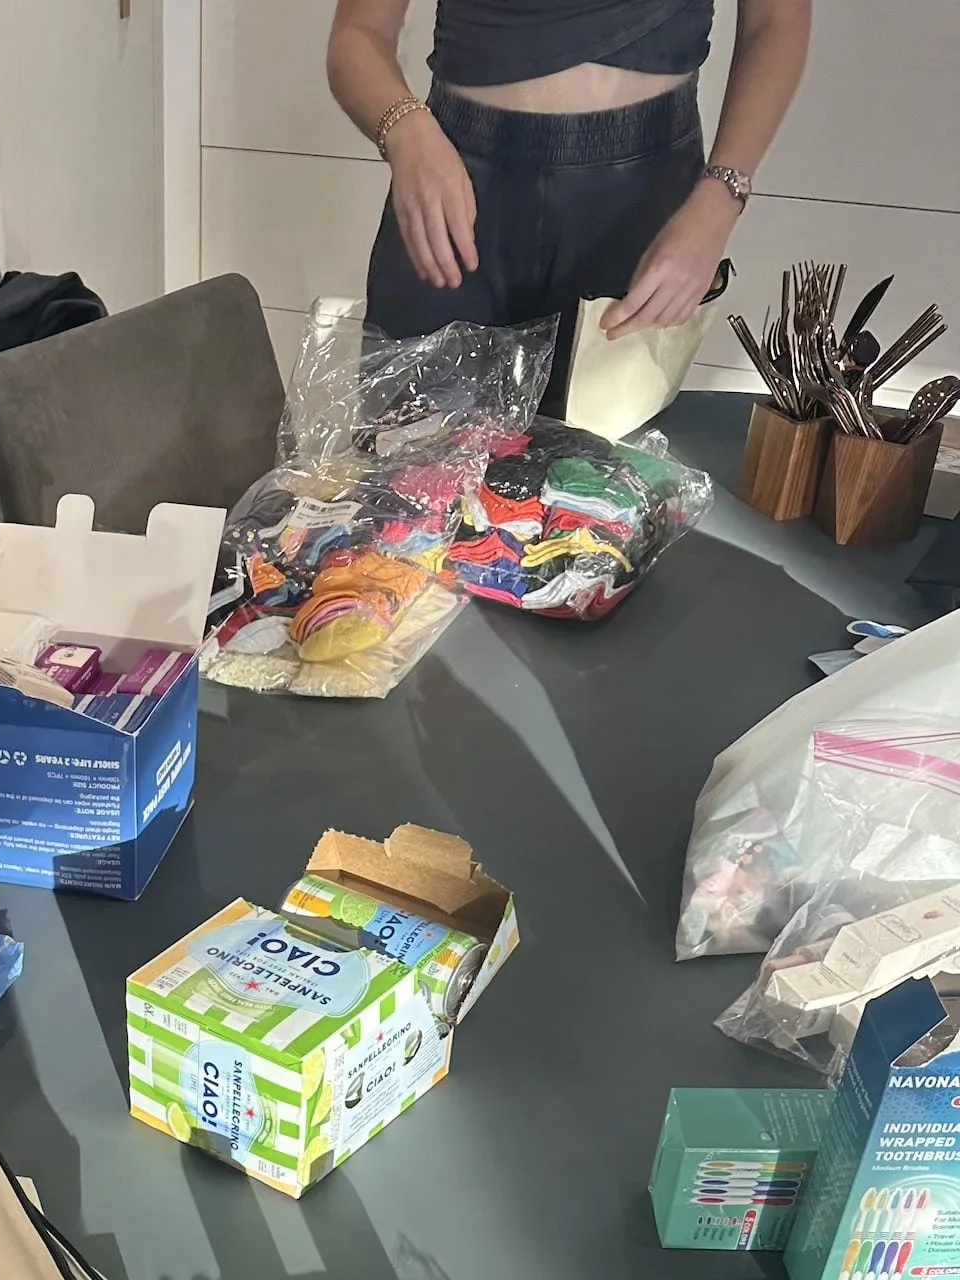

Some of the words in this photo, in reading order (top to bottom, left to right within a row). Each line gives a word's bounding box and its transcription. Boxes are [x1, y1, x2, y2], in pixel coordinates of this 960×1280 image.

[64, 757, 70, 765] 2
[74, 807, 95, 815] NOTE:
[96, 808, 120, 816] USAGE
[68, 832, 105, 841] FEATURES:
[247, 931, 341, 978] CIAO!
[205, 944, 332, 1006] SANPELLEGRINO
[347, 1022, 412, 1078] SANPELLEGRINO
[366, 1062, 396, 1094] CIAO!
[202, 1060, 218, 1130] CIAO!
[230, 1059, 241, 1151] SANPELLEGRINO
[879, 1137, 955, 1147] WRAPPED
